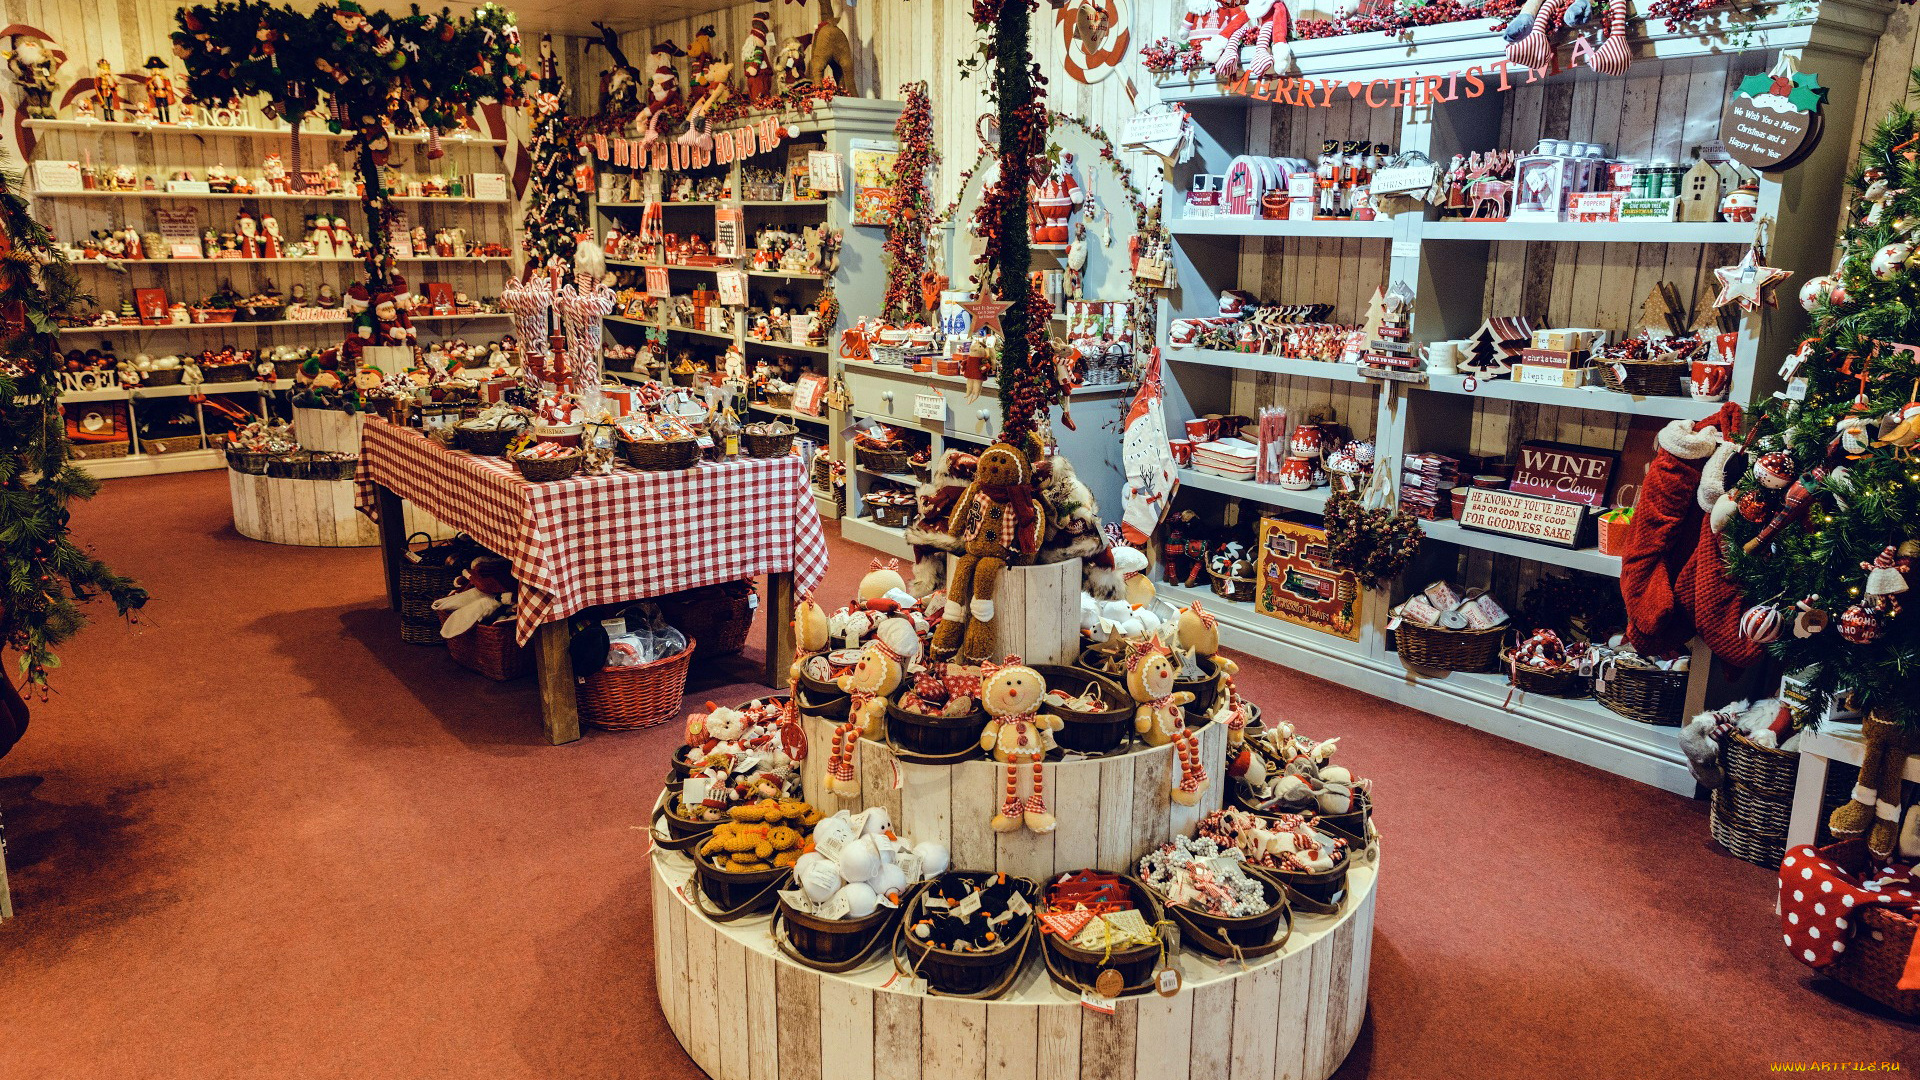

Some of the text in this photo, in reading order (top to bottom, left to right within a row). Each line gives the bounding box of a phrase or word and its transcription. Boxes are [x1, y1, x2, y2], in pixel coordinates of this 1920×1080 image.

[1225, 69, 1344, 109] MERRY
[1733, 106, 1802, 134] We Wish You a Merry
[1736, 123, 1767, 139] Christmas
[1766, 133, 1781, 143] and
[715, 131, 734, 165] HO
[735, 125, 756, 161] HO
[758, 115, 781, 154] HO
[1728, 136, 1782, 159] Happy New Year
[1527, 354, 1567, 364] christmas
[1521, 449, 1607, 480] WINE
[1515, 470, 1554, 489] How
[1556, 476, 1598, 503] Classy
[1471, 491, 1579, 518] HE KNOWS IF YOU'VE BEEN
[1472, 503, 1487, 513] BAD
[1487, 505, 1498, 514] OR
[1522, 511, 1533, 519] SO
[1533, 513, 1543, 522] BE
[1544, 515, 1567, 526] GOOD
[1464, 512, 1573, 541] FOR GOODNESS SAKE
